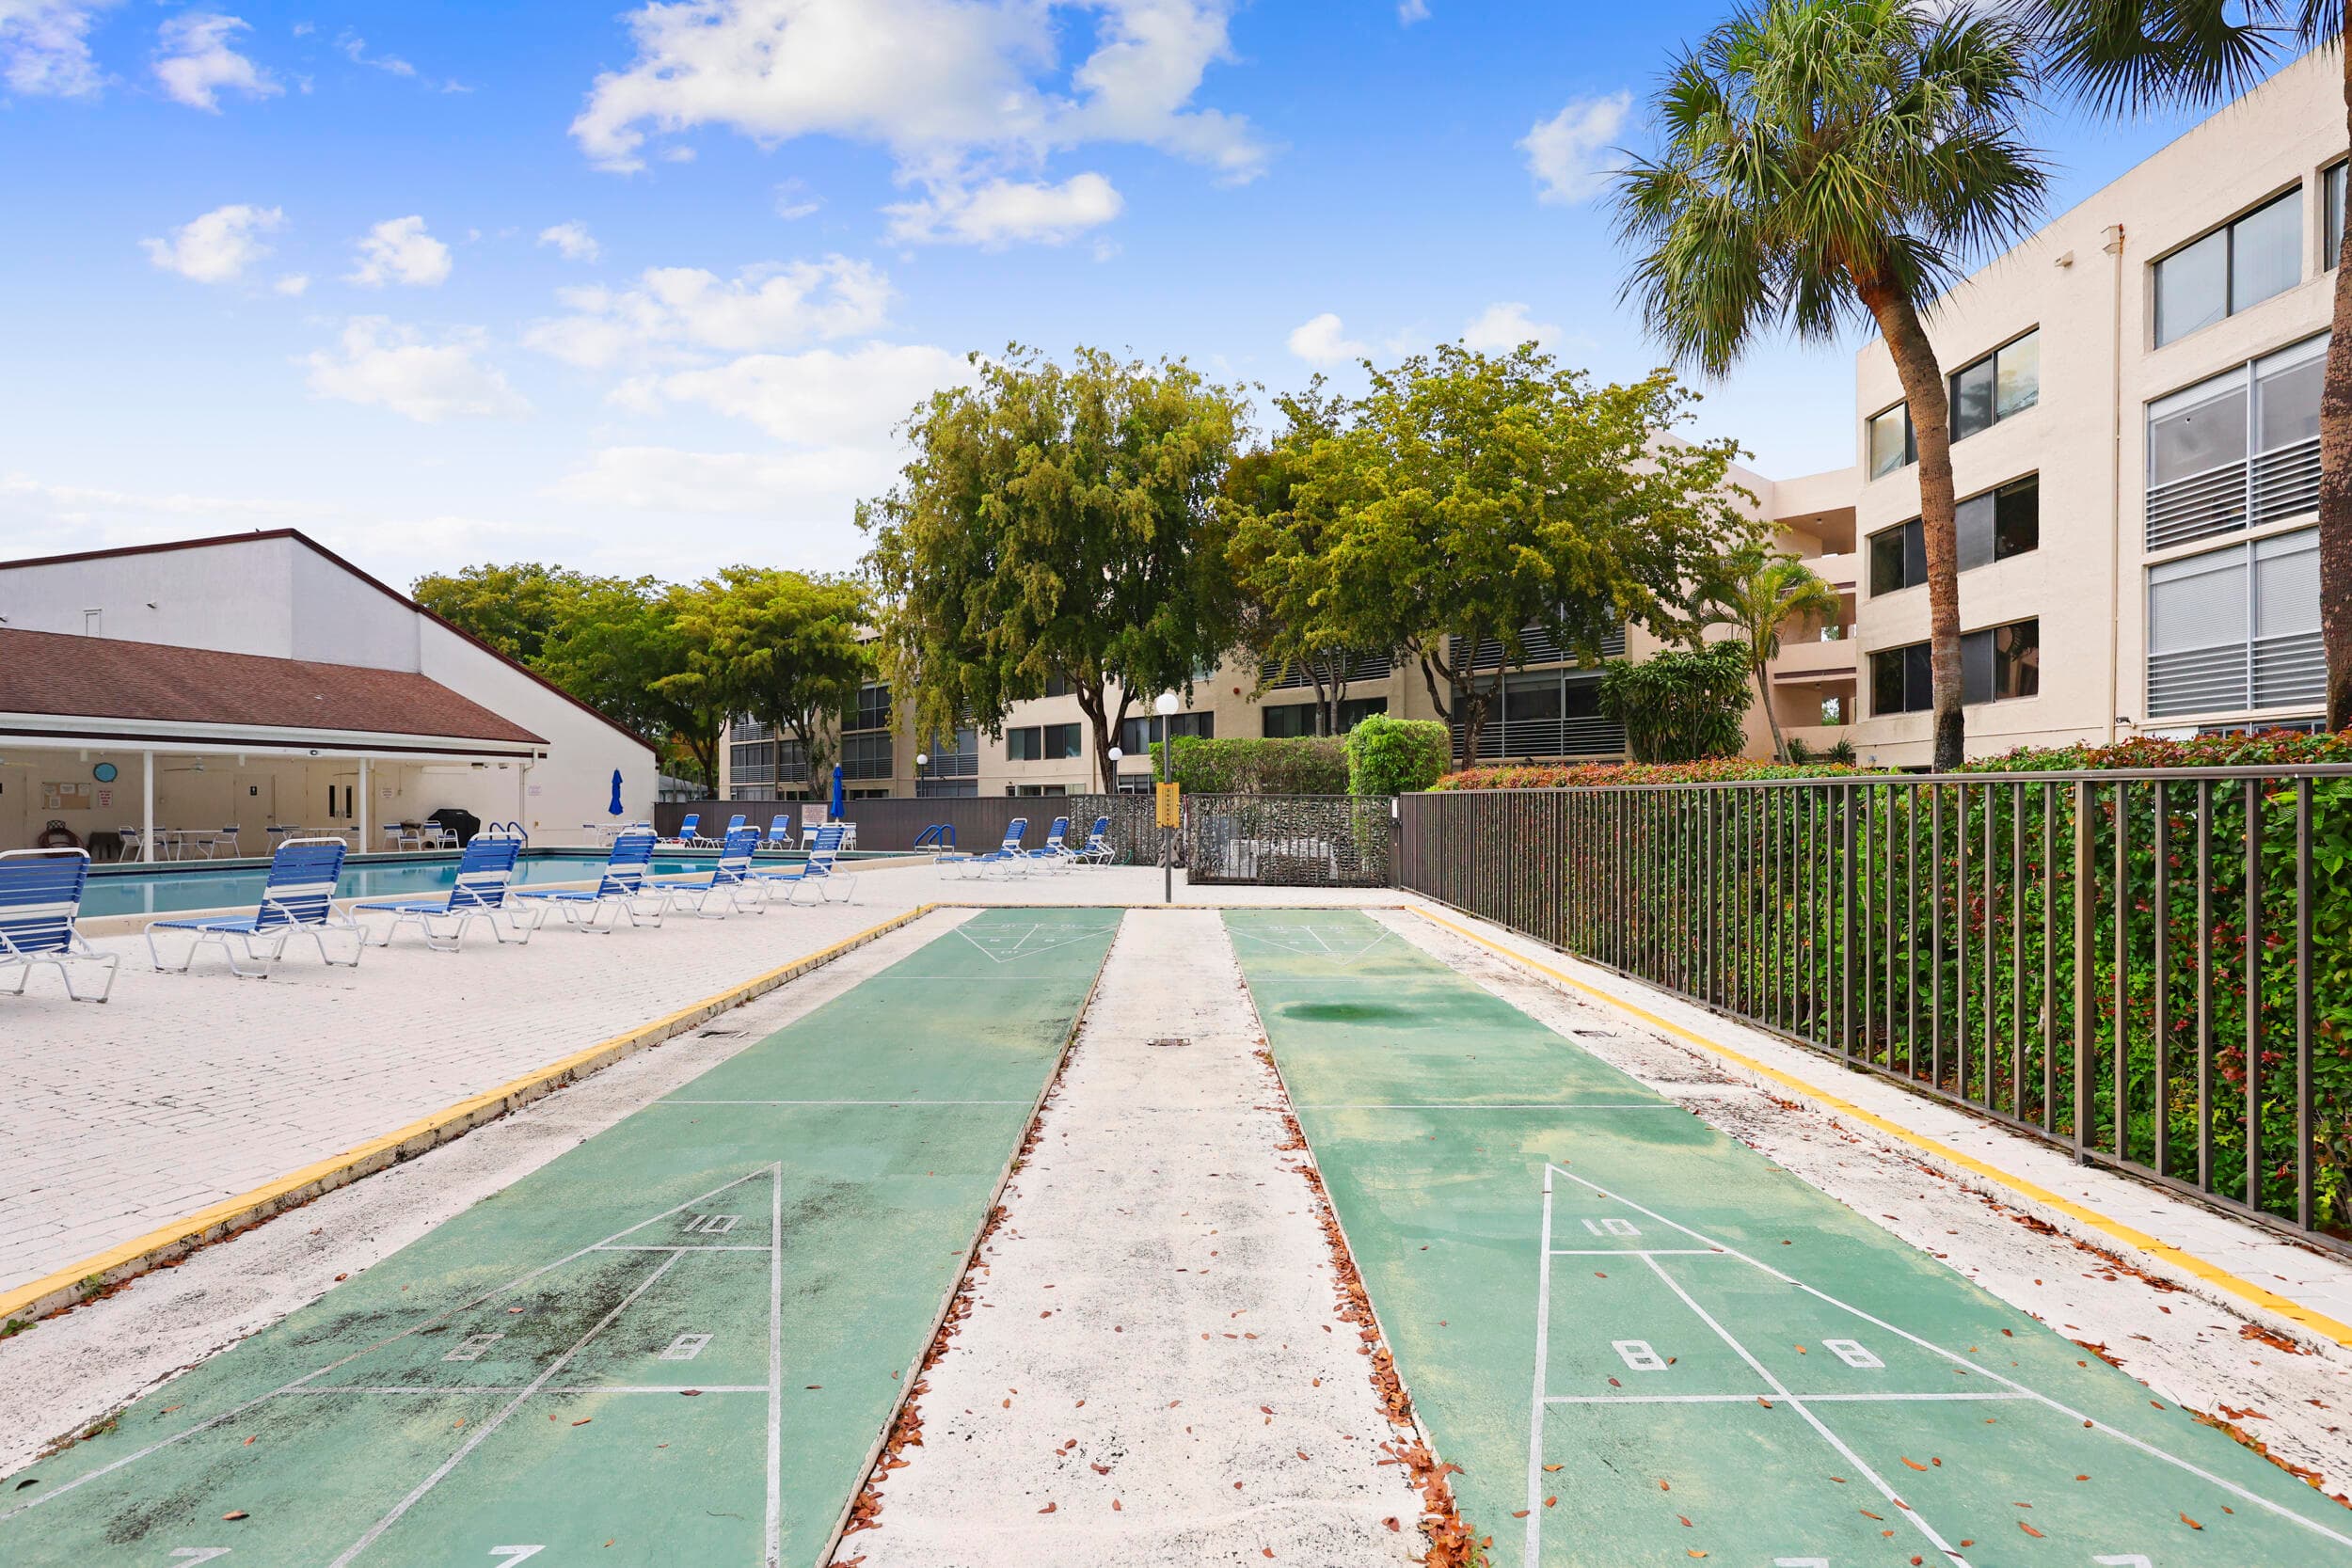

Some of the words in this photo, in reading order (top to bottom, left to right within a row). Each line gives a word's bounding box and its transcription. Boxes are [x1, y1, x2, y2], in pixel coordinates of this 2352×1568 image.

[682, 1215, 742, 1232] 10
[1581, 1219, 1642, 1235] 10
[441, 1334, 505, 1361] 8
[659, 1334, 714, 1359] 8
[1612, 1339, 1669, 1370] 8
[1822, 1339, 1885, 1368] 8
